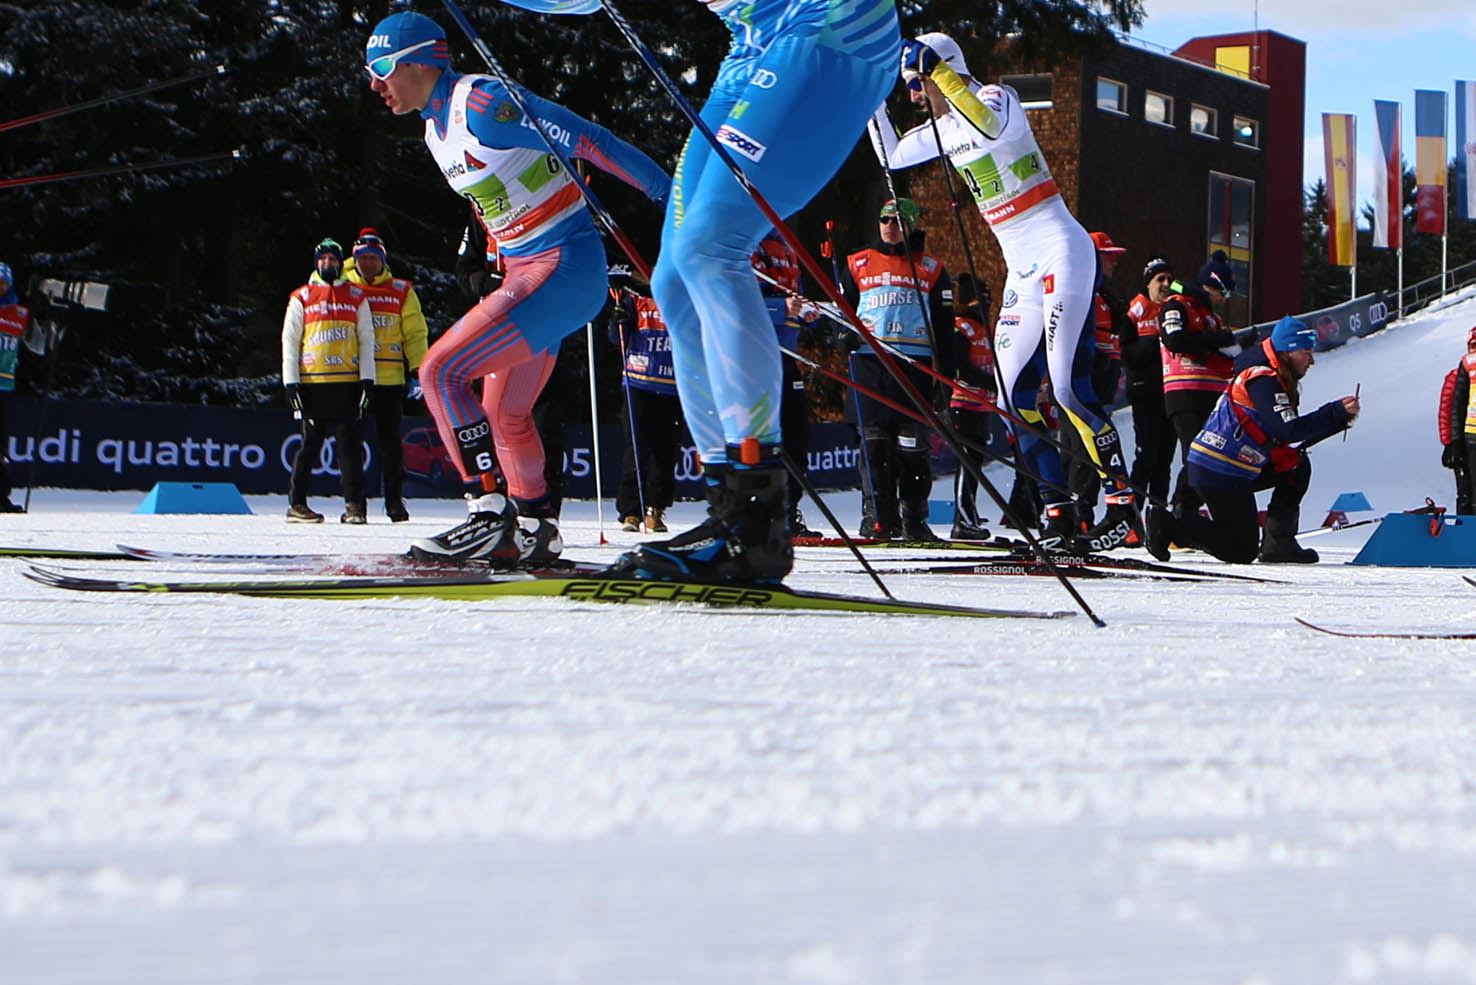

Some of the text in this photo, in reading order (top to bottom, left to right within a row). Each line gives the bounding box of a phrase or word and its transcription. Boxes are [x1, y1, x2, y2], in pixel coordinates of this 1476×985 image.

[963, 166, 982, 199] 4
[647, 336, 673, 352] TEA
[8, 429, 266, 476] udi quattro
[475, 451, 493, 471] 6
[807, 445, 861, 471] uattr
[1110, 453, 1121, 467] 4
[973, 566, 1027, 575] ROSSIGNOL
[560, 581, 772, 606] FISCHER
